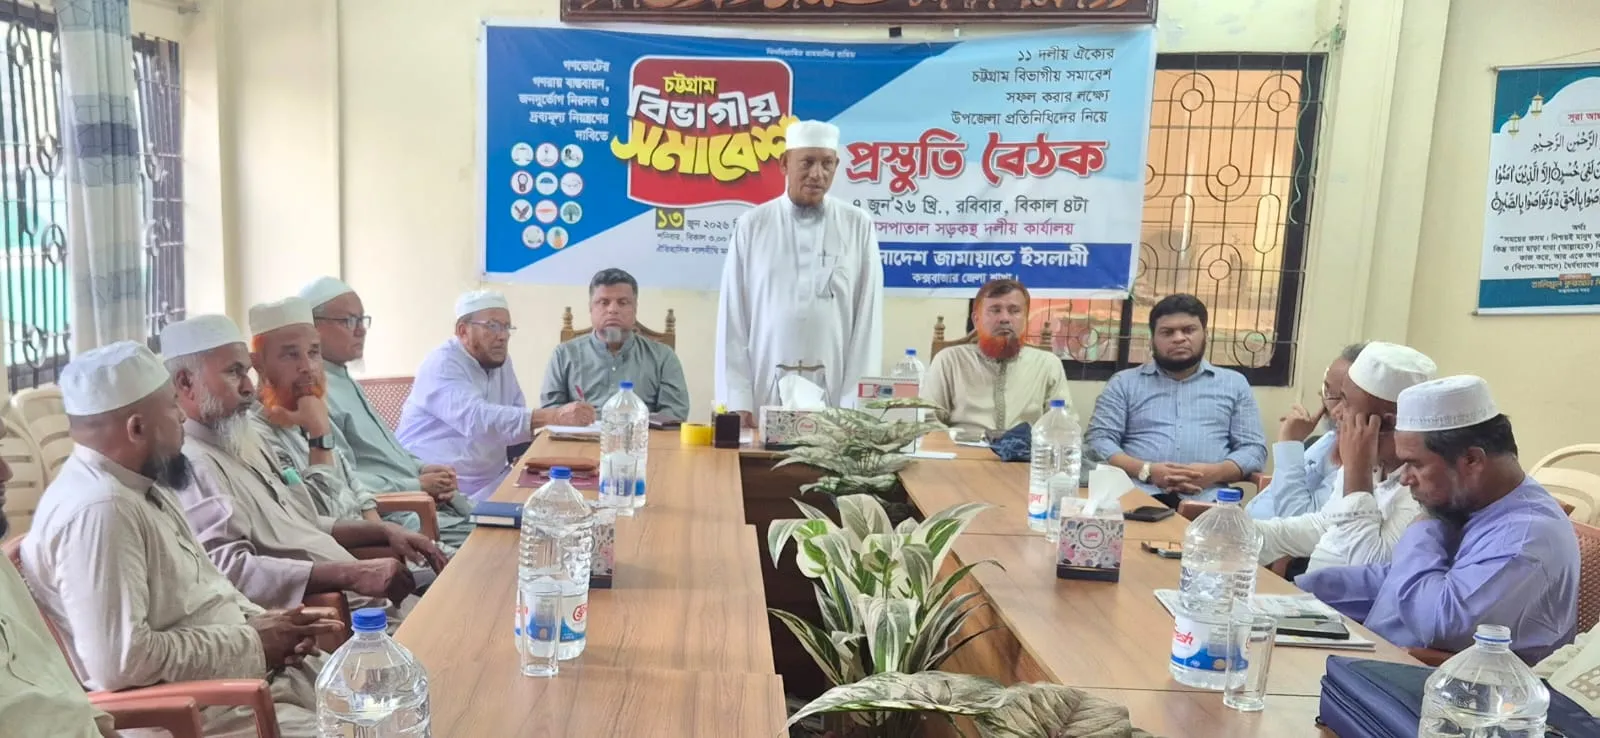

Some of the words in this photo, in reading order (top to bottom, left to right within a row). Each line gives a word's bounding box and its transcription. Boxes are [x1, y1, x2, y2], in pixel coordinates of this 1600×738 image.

[1018, 49, 1032, 62] ১১
[1038, 46, 1069, 61] দলীয়
[1073, 45, 1115, 60] ঐক্যের
[662, 70, 717, 95] চট্টগ্রাম
[972, 67, 1010, 83] চট্টগ্রাম
[1014, 66, 1062, 82] বিভাগীয়
[1066, 68, 1113, 81] সমাবেশ
[600, 96, 610, 107] ও
[1005, 91, 1038, 104] সফল
[1042, 91, 1072, 103] করার
[1076, 89, 1110, 103] লক্ষ্যে
[627, 85, 781, 129] বিভাগীয়
[951, 110, 1002, 125] উপজেলা
[1004, 109, 1078, 125] প্রতিনিধিদের
[1081, 108, 1109, 123] নিয়ে
[610, 114, 800, 182] সমাবেশ
[846, 127, 968, 195] প্রস্তুতি
[980, 131, 1109, 186] বৈঠক
[1015, 195, 1058, 214] বিকাল
[1063, 195, 1090, 213] ৪টা
[657, 209, 683, 229] ১৩
[686, 219, 701, 230] জুন
[703, 220, 729, 230] ২০২৬
[874, 221, 929, 236] াসপাতাল
[934, 221, 978, 237] সড়কস্থ
[984, 218, 1018, 236] দলীয়
[1024, 218, 1076, 236] কার্যালয়
[933, 248, 1015, 269] জামায়াতে
[1020, 243, 1090, 267] ইসলামী
[912, 271, 959, 285] কক্সবাজার
[962, 271, 986, 284] জেলা
